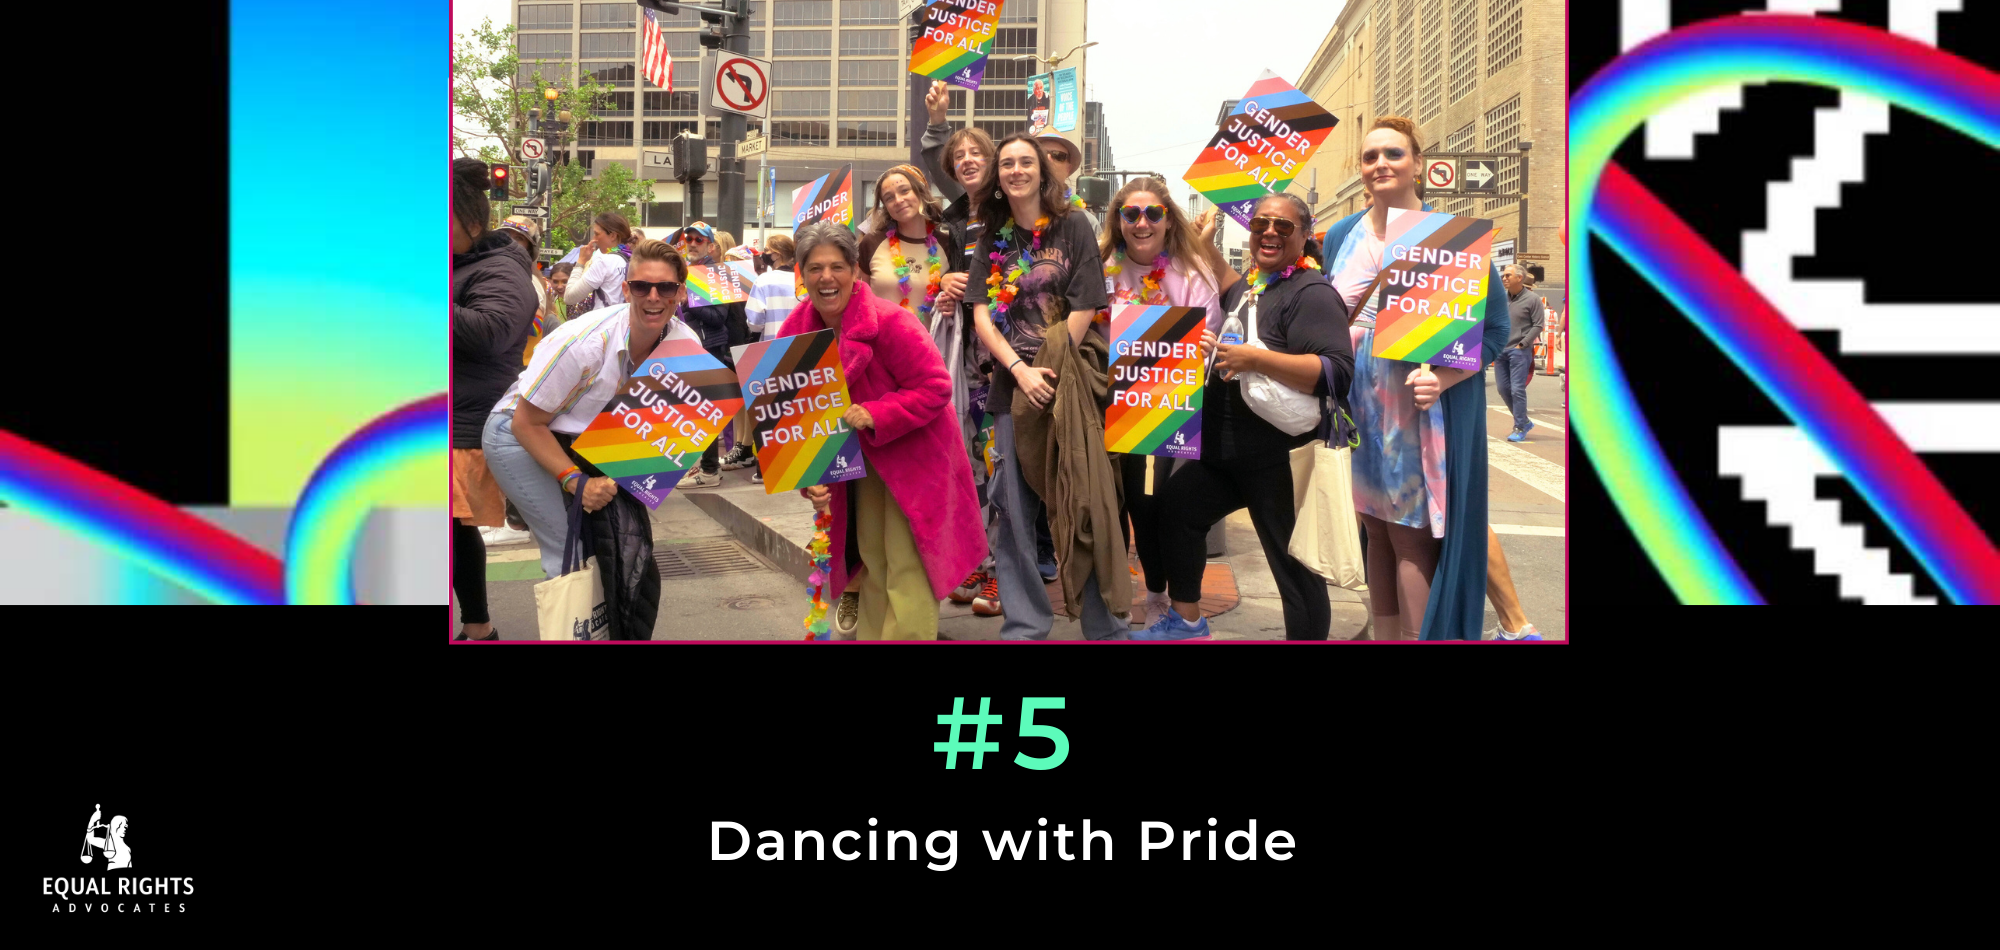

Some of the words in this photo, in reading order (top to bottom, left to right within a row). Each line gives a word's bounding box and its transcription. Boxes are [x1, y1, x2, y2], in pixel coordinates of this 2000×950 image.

[929, 7, 992, 36] JUSTICE
[923, 26, 955, 46] FOR
[956, 37, 984, 55] ALL
[1244, 100, 1311, 156] GENDER
[741, 141, 762, 154] MARKET
[1228, 118, 1297, 175] JUSTICE
[1213, 137, 1249, 170] FOR
[1247, 165, 1279, 193] ALL
[797, 191, 848, 224] GENDER
[1391, 244, 1482, 270] GENDER
[705, 267, 716, 286] FOR
[717, 265, 731, 301] JUSTICE
[729, 264, 743, 300] GENDER
[1387, 269, 1481, 296] JUSTICE
[708, 286, 719, 303] ALL
[1386, 294, 1430, 316] FOR
[1437, 302, 1477, 322] ALL
[1116, 340, 1198, 360] GENDER
[748, 366, 838, 397] GENDER
[1114, 365, 1197, 385] JUSTICE
[648, 361, 724, 427] GENDER
[754, 391, 844, 422] JUSTICE
[1113, 390, 1152, 408] FOR
[1158, 393, 1195, 411] ALL
[629, 380, 708, 447] JUSTICE
[611, 401, 653, 440] FOR
[651, 435, 687, 468] ALL
[760, 425, 806, 448] FOR
[811, 417, 849, 438] ALL
